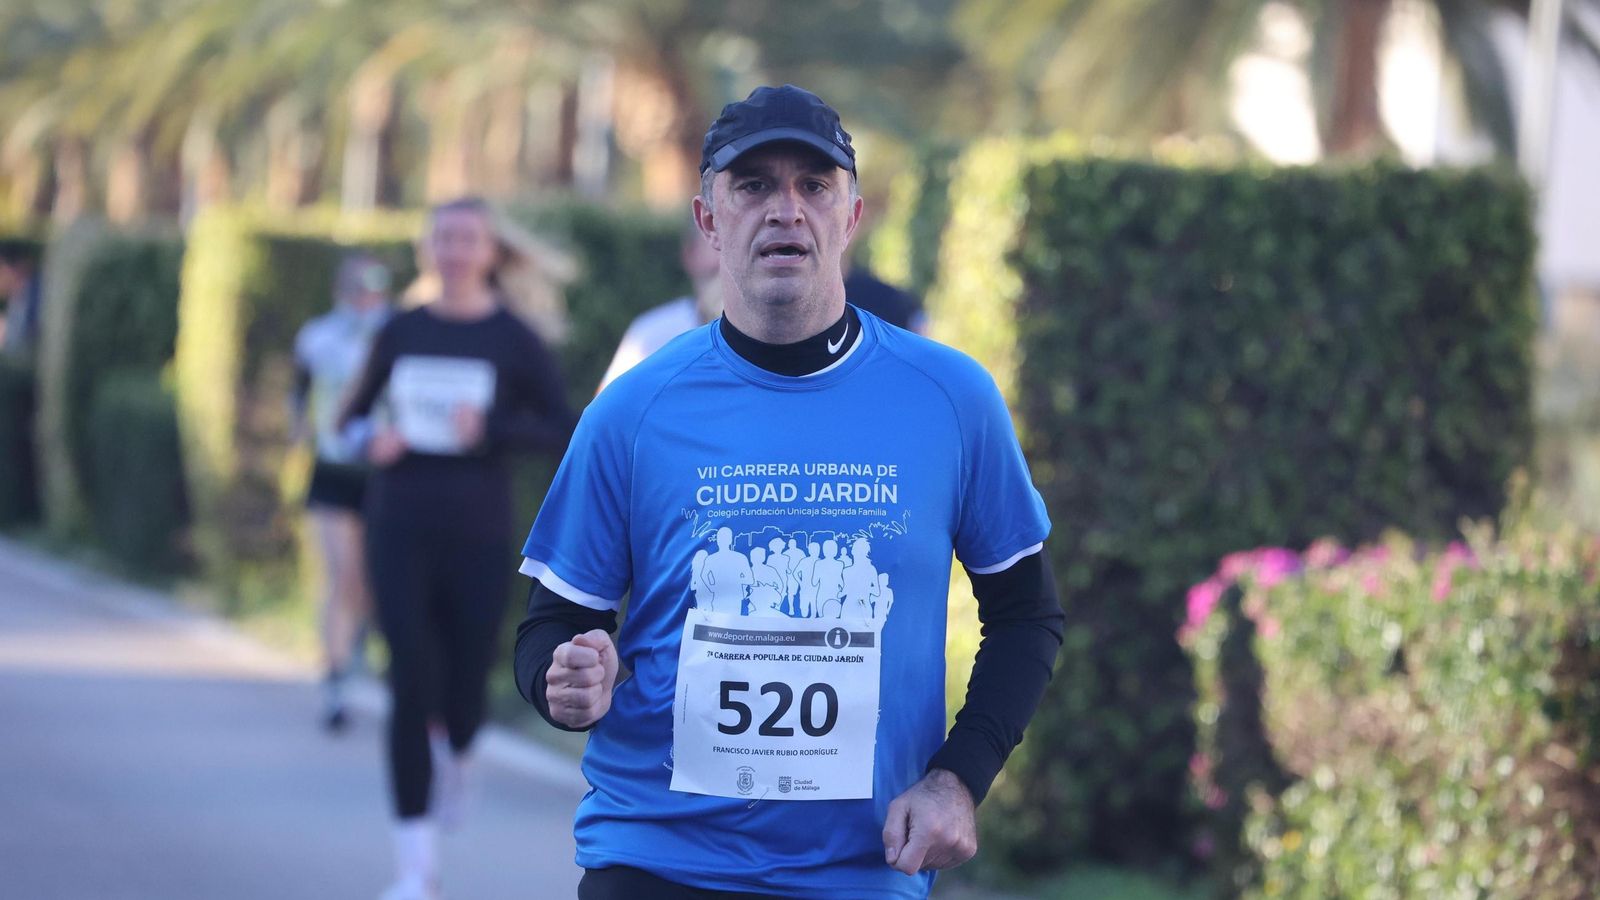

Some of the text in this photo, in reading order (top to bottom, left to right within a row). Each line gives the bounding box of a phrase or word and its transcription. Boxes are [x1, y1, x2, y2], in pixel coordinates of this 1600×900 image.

[697, 463, 898, 480] VII CARRERA URBANA DE
[696, 478, 898, 506] CIUDAD JARDÍN
[707, 507, 887, 519] Colegio Fundación Unicaja Sagrada Familia
[707, 631, 796, 643] www.deporte.malaga.eu
[714, 651, 751, 661] CARRERA
[753, 653, 790, 661] POPULAR
[791, 654, 802, 662] DE
[803, 654, 834, 662] CIUDAD
[834, 654, 864, 663] JARDÍN
[717, 680, 839, 737] 520
[712, 745, 839, 757] FRANCISCO JAVIER RUBIO RODRÍGUEZ
